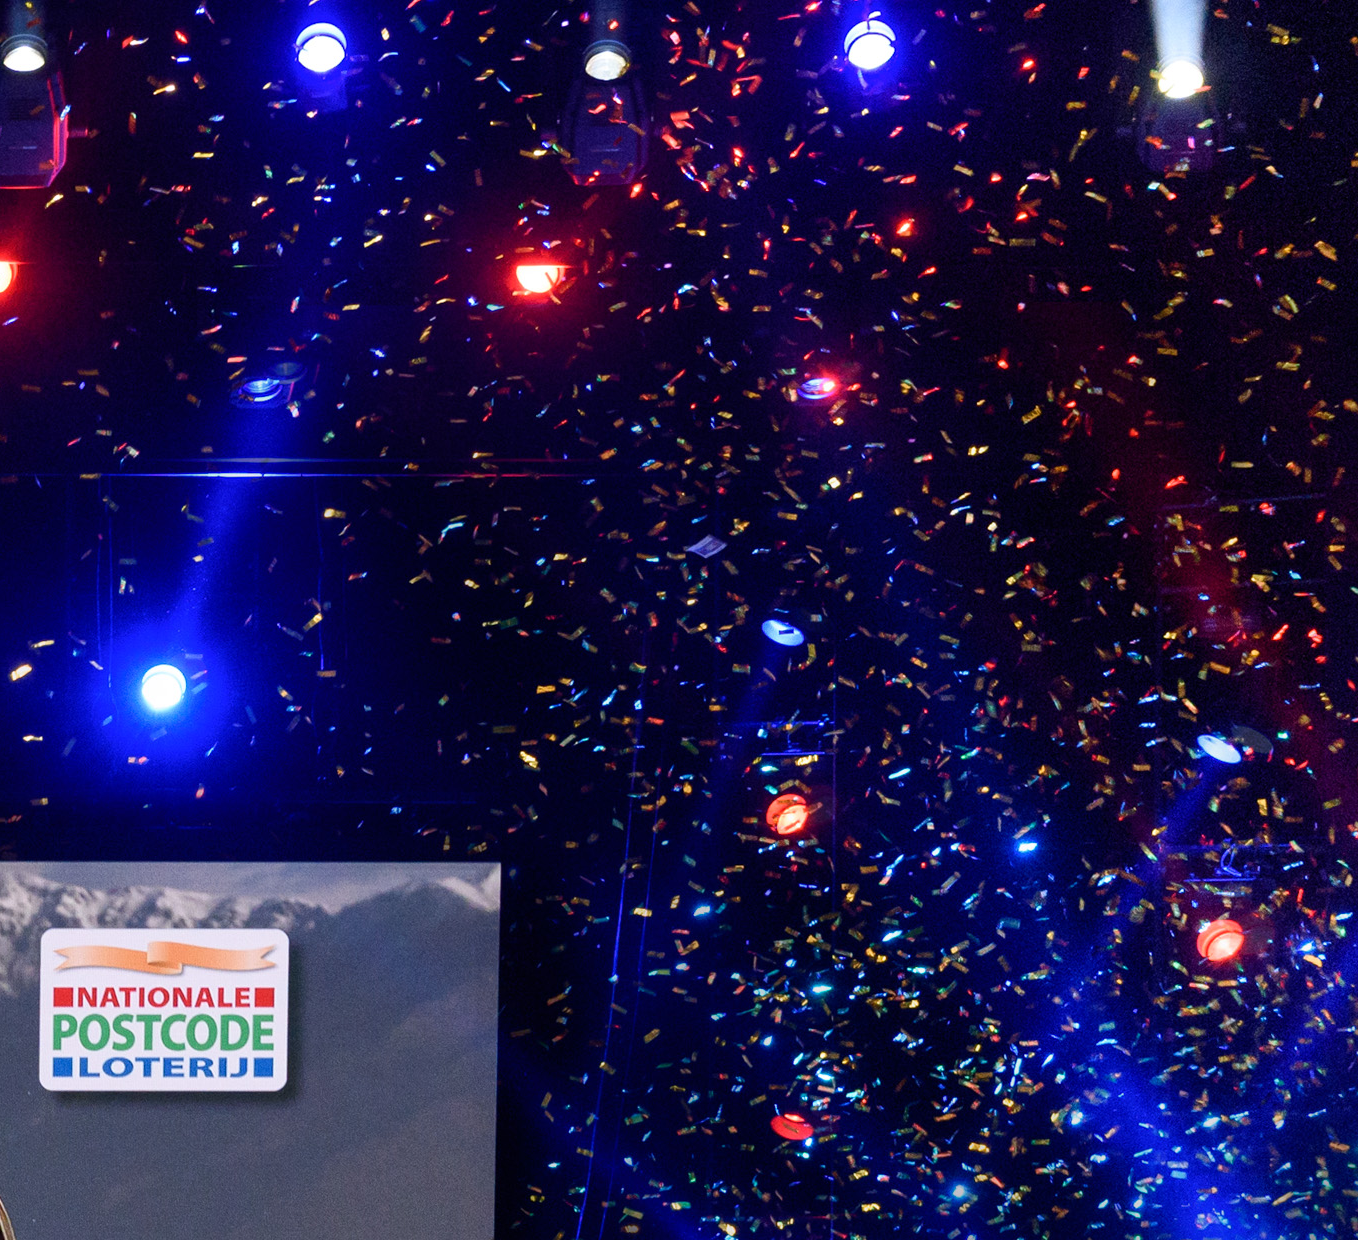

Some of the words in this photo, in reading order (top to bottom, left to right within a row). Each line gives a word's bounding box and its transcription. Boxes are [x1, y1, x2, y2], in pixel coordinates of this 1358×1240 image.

[77, 986, 251, 1008] NATIONALE
[52, 1013, 275, 1052] POSTCODE
[78, 1056, 248, 1078] LOTERIJ
